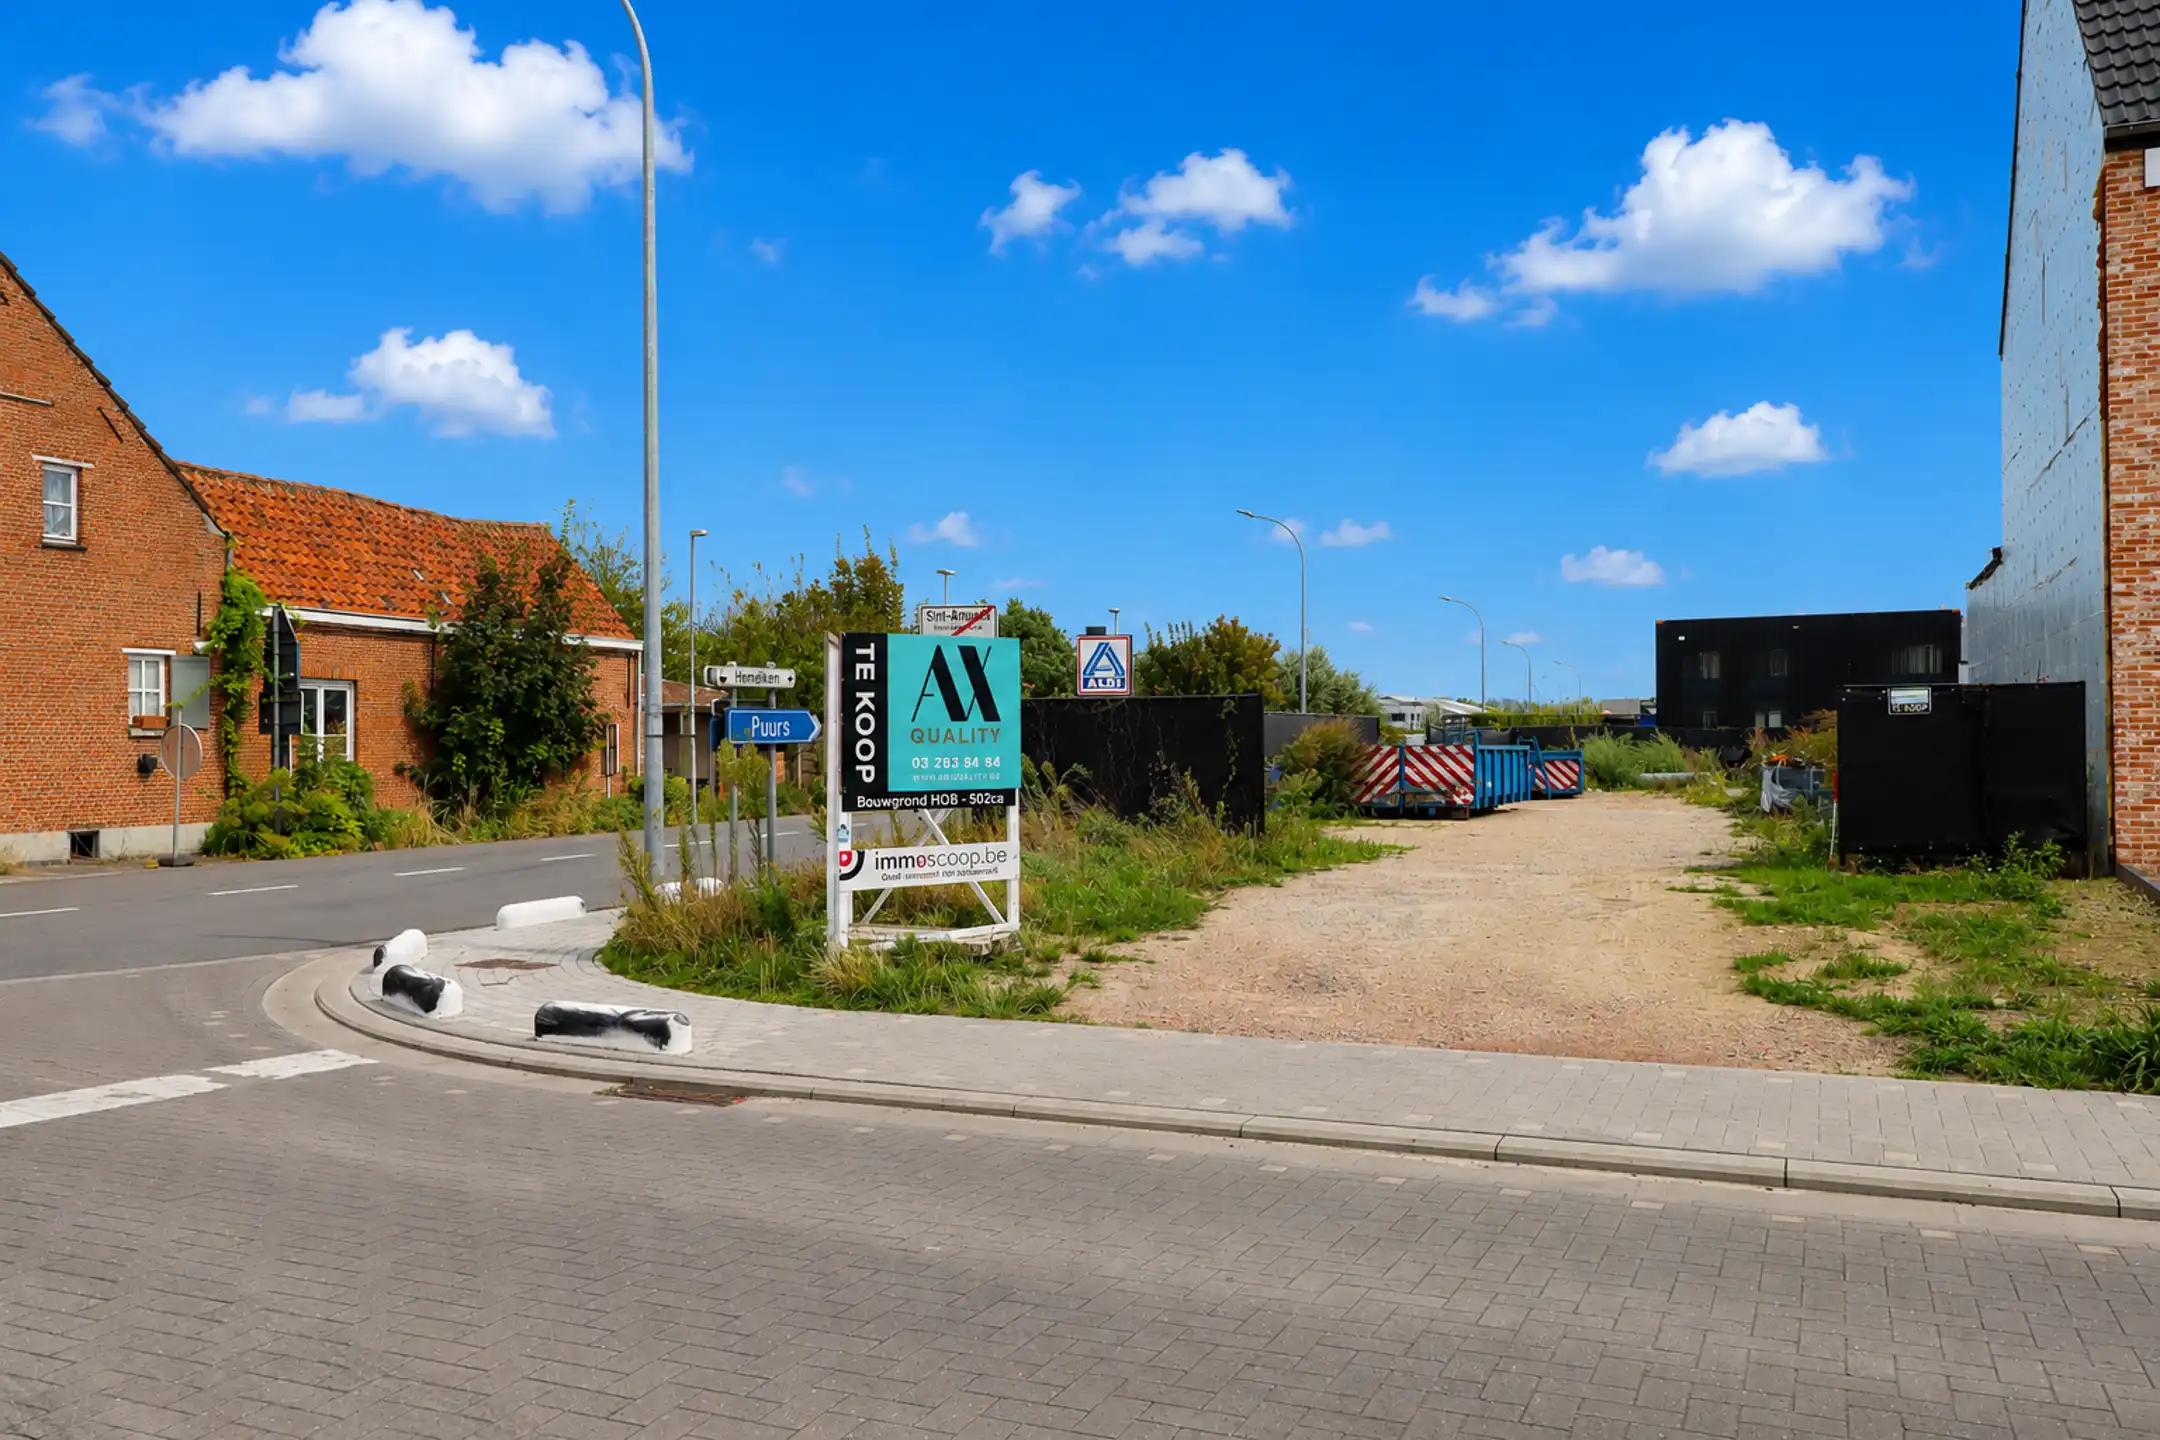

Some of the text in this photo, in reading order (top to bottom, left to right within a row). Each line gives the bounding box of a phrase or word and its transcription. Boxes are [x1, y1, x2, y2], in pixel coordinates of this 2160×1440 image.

[1087, 677, 1122, 689] ALDI
[855, 642, 876, 783] TE KOOP
[751, 715, 791, 738] Puurs
[910, 727, 1000, 744] QUALITY
[911, 757, 929, 769] 03
[857, 794, 927, 809] Bouwgrond
[875, 847, 1008, 870] immoscoop.be
